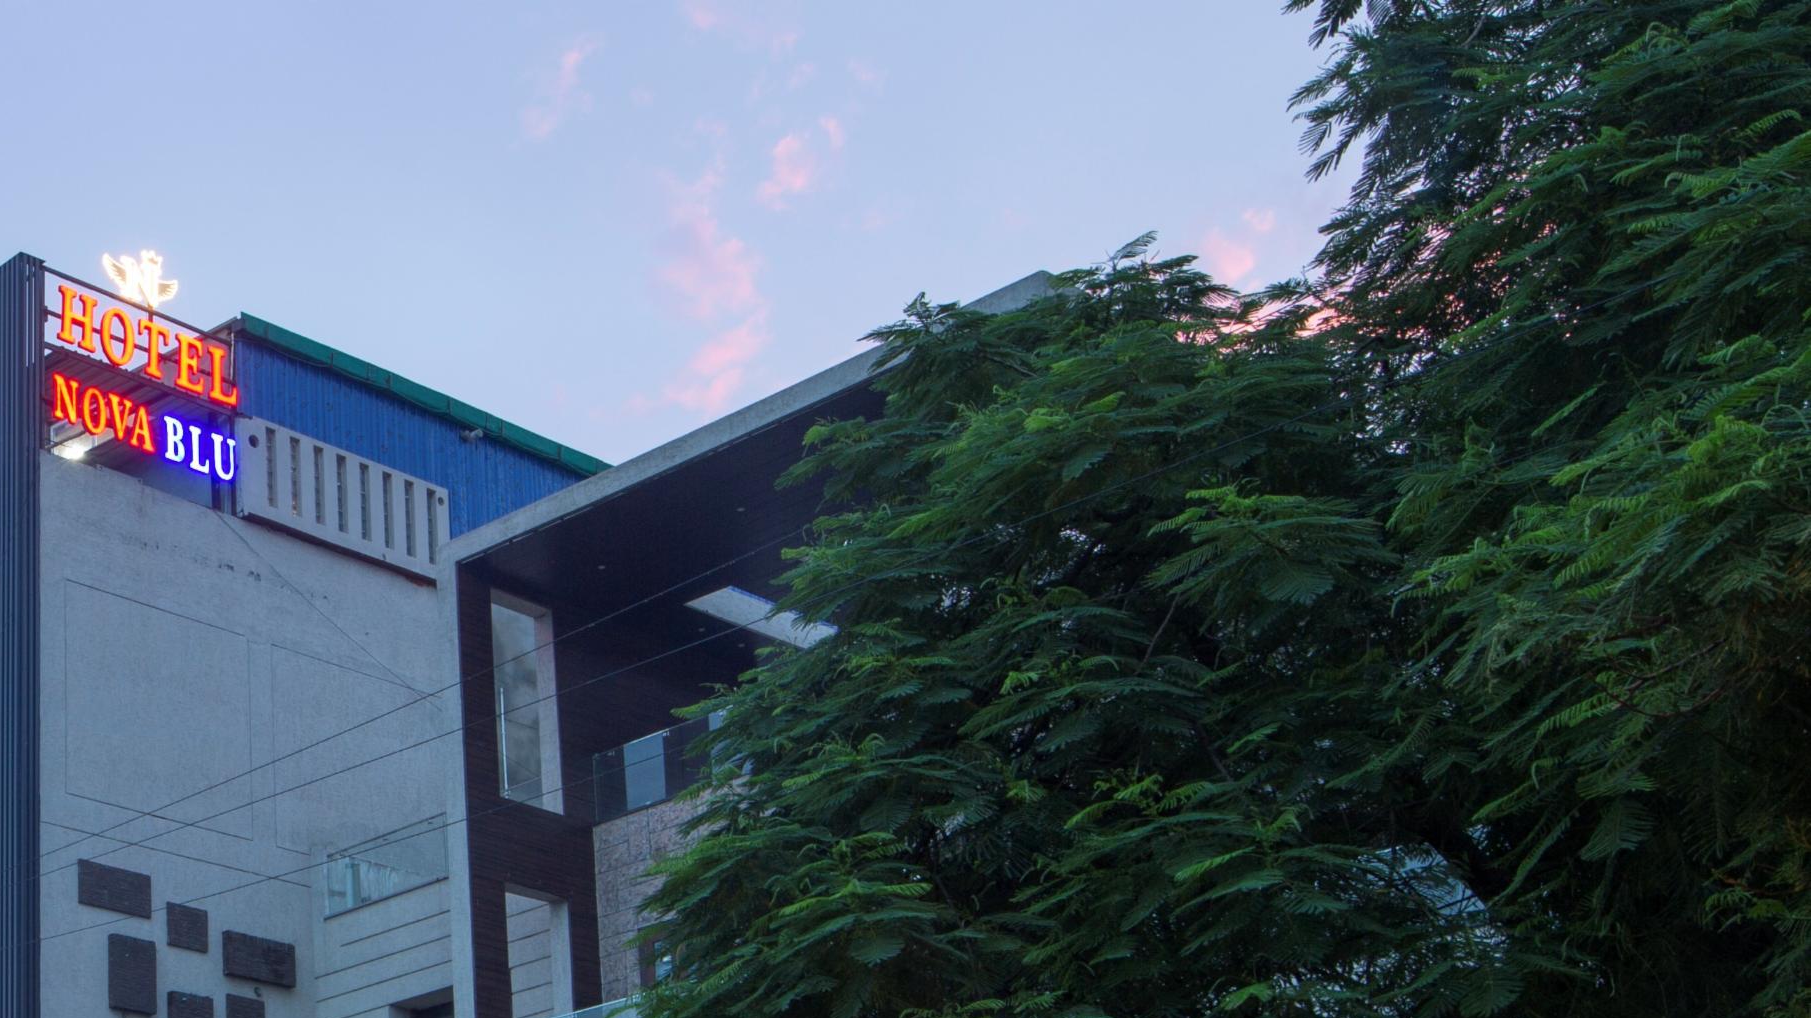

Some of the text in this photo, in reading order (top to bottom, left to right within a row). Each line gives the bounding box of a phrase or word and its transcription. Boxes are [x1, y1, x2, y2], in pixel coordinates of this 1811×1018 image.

[57, 284, 238, 406] HOTEL
[53, 373, 236, 481] NOVA BLU
